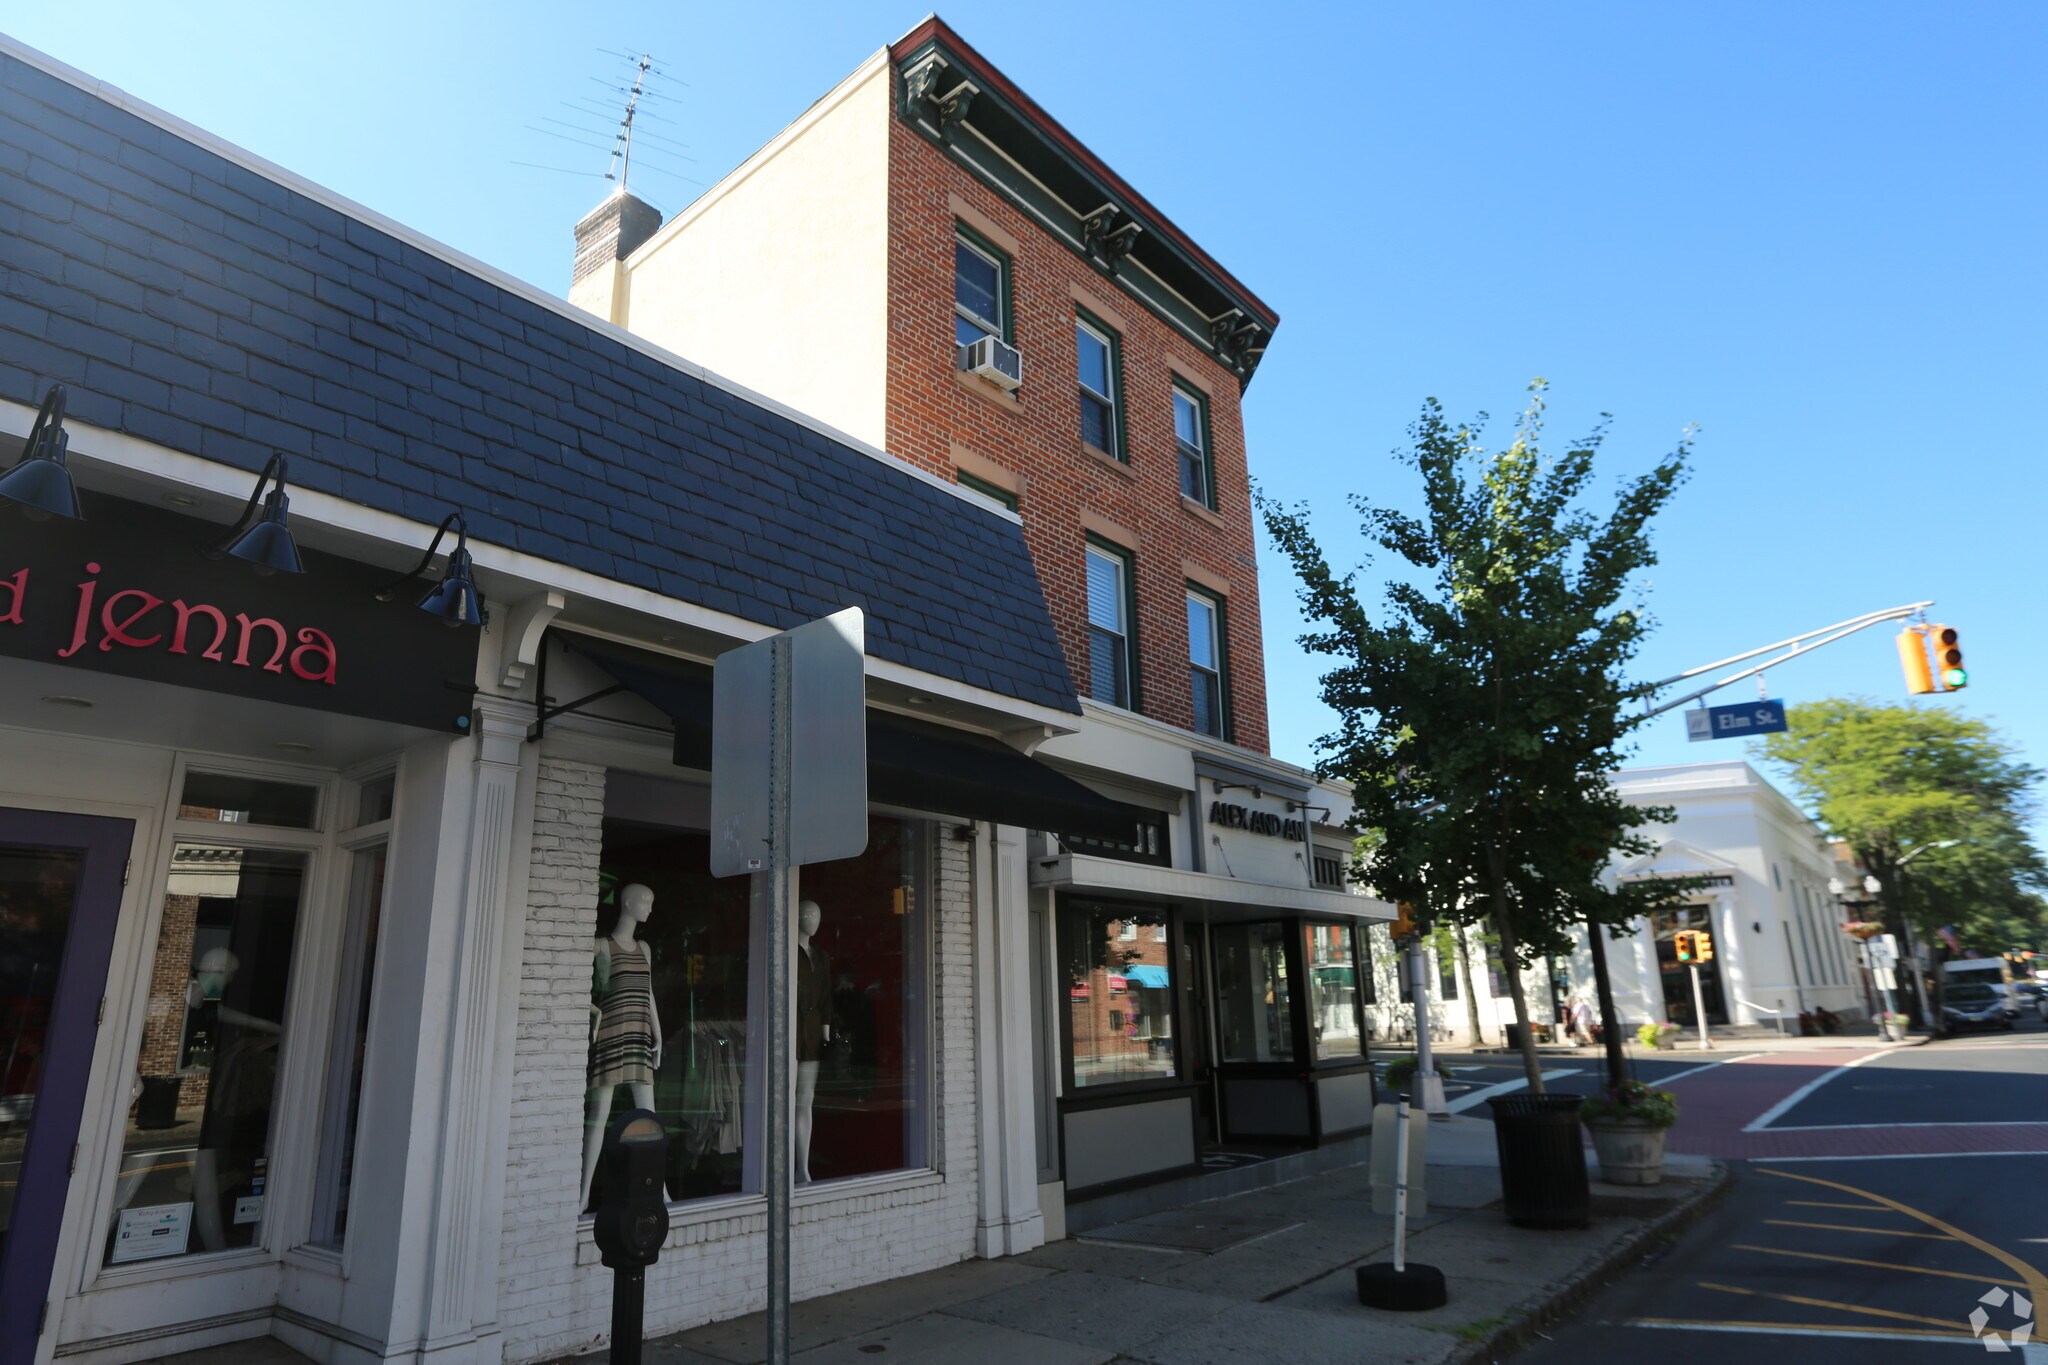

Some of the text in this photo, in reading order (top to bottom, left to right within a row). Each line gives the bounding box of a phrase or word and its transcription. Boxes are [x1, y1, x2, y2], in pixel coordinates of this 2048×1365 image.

[57, 562, 337, 685] jenna
[1718, 713, 1752, 730] Elm
[1208, 801, 1249, 830] ALEX
[1249, 810, 1281, 836] AND
